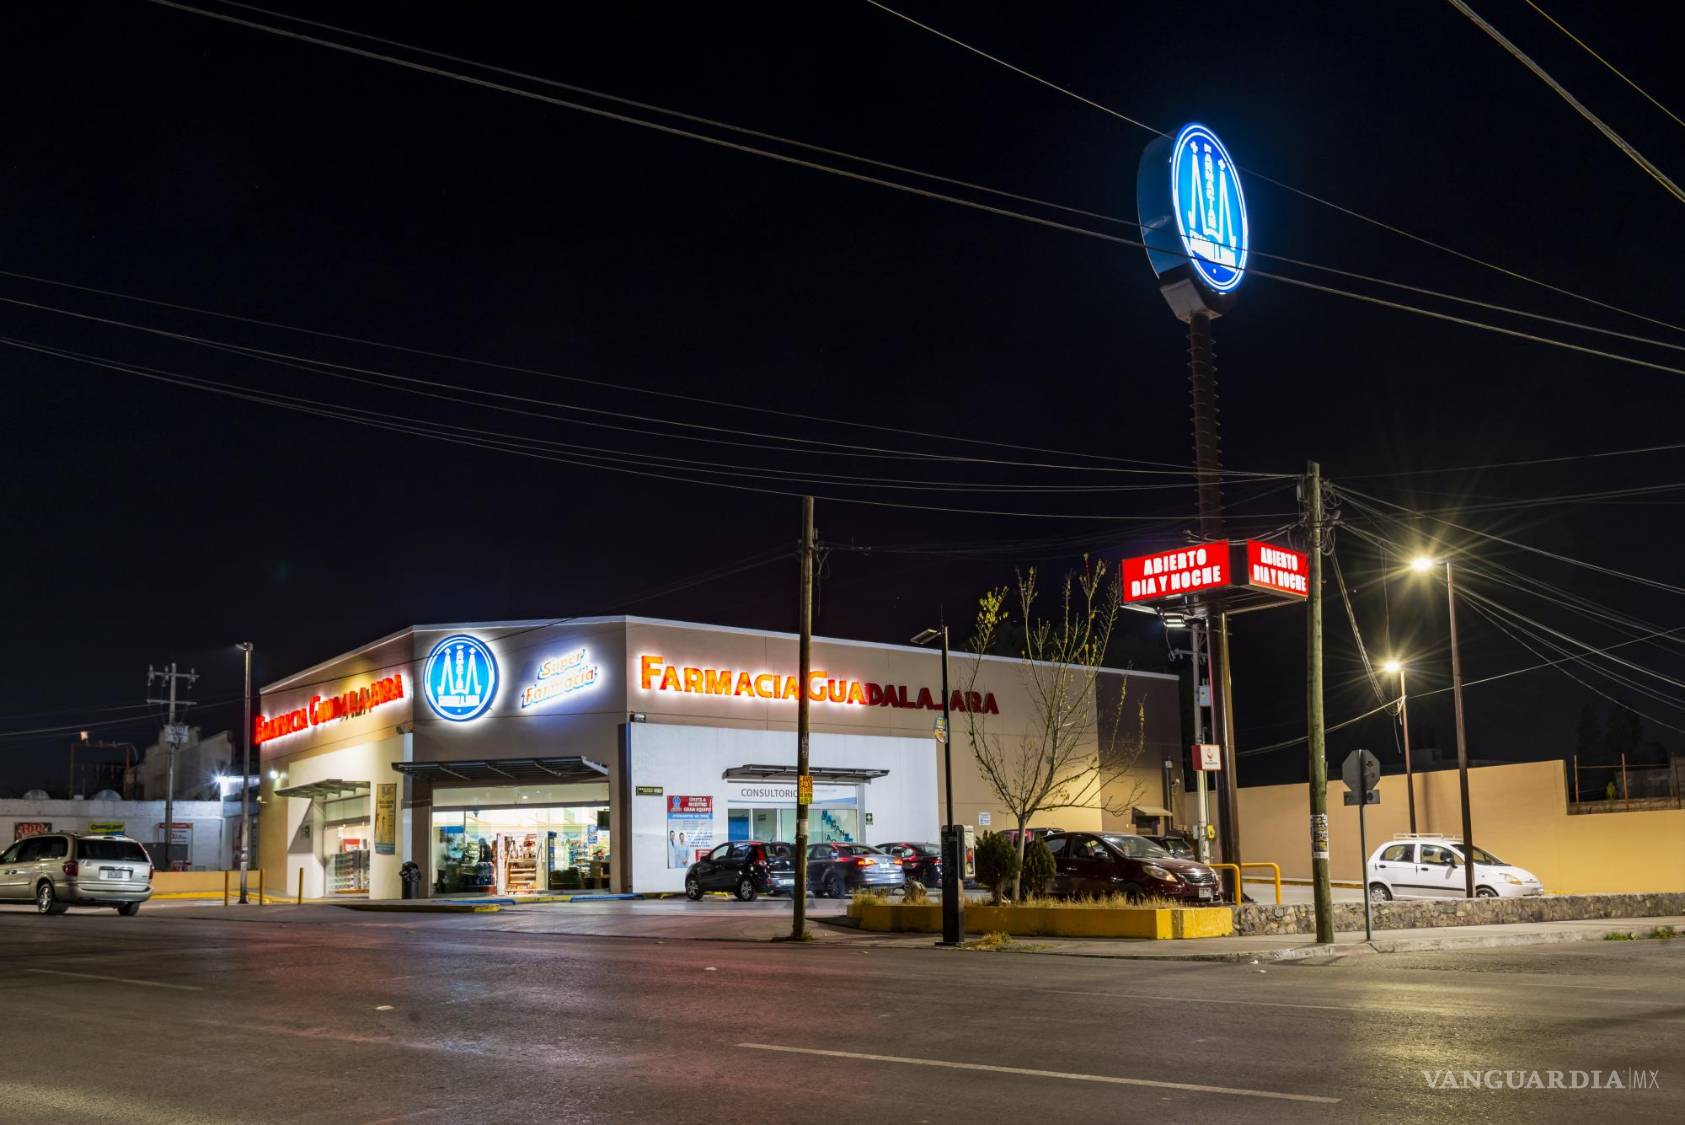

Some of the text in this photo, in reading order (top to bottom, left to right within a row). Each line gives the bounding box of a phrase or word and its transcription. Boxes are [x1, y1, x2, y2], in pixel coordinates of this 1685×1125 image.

[1143, 548, 1207, 576] ABIERTO
[1260, 546, 1298, 572] ABIERTO
[1131, 565, 1221, 597] DIA Y NOCHE
[1253, 564, 1307, 592] DIA Y NOCHE
[538, 651, 584, 679] Super
[640, 655, 800, 700] FARMACIA
[523, 667, 597, 706] Farmacia
